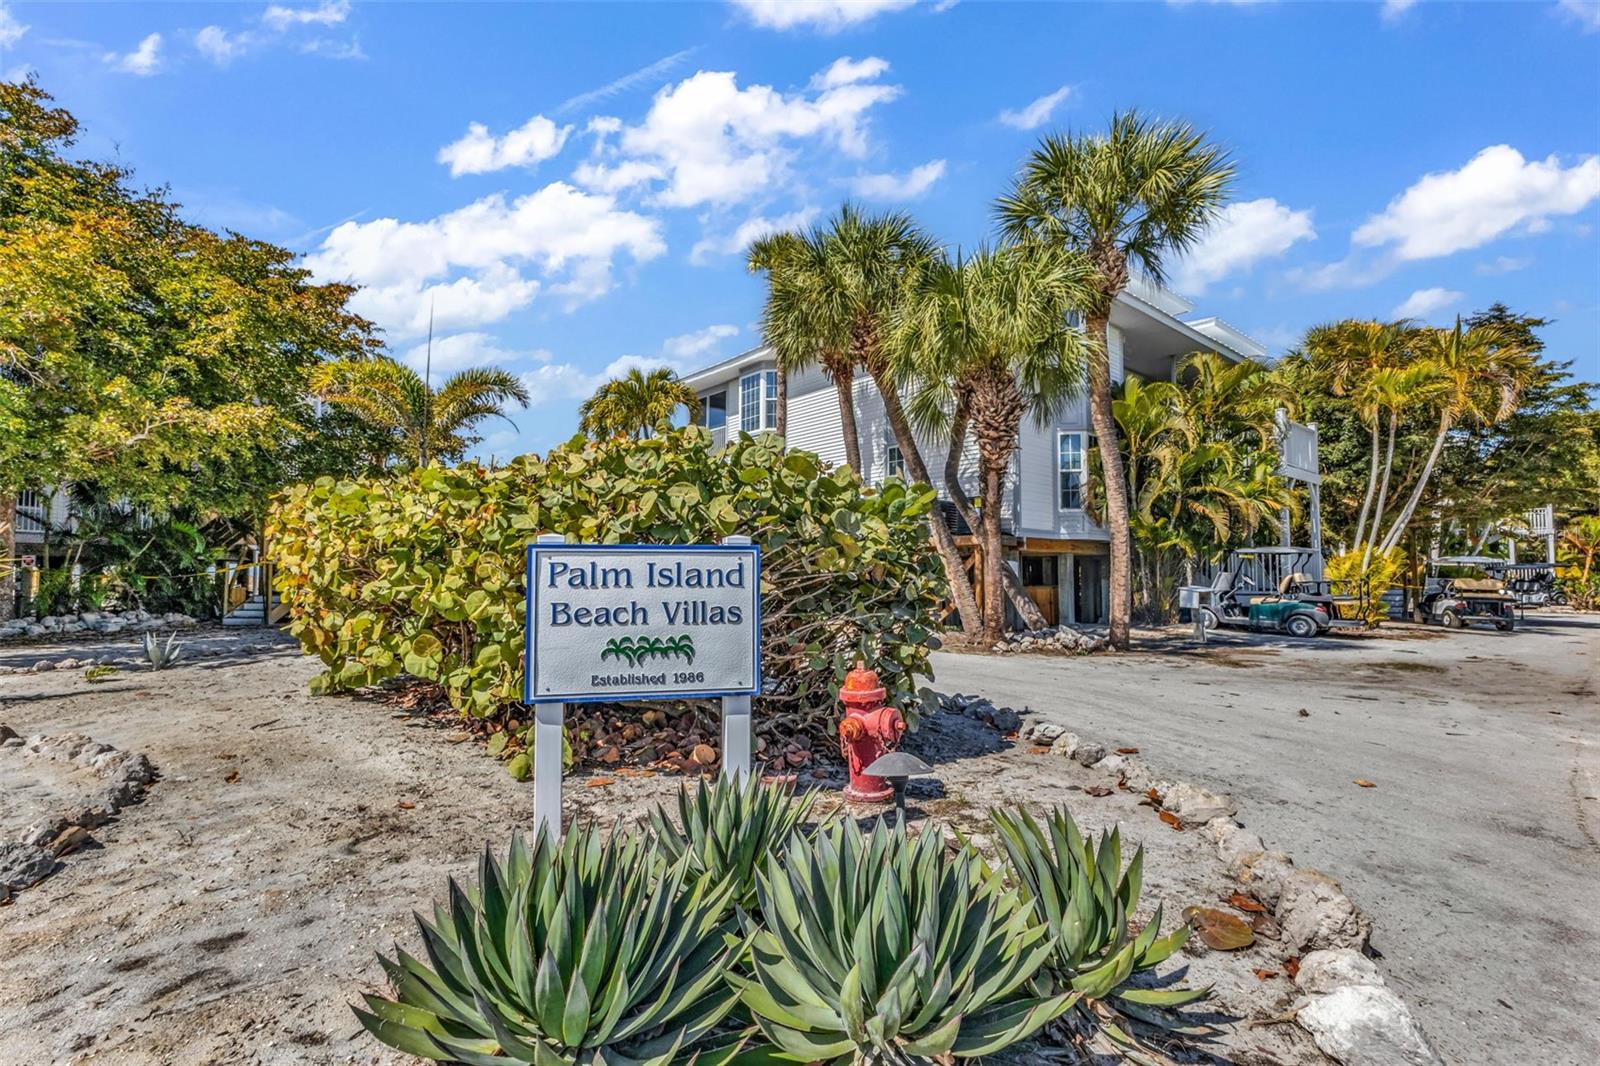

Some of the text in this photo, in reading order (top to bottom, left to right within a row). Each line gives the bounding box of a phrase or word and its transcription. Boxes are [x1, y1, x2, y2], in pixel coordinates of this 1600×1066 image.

[548, 561, 745, 589] Palm Island
[550, 600, 743, 627] Beach Villas
[591, 672, 705, 687] Established 1986
